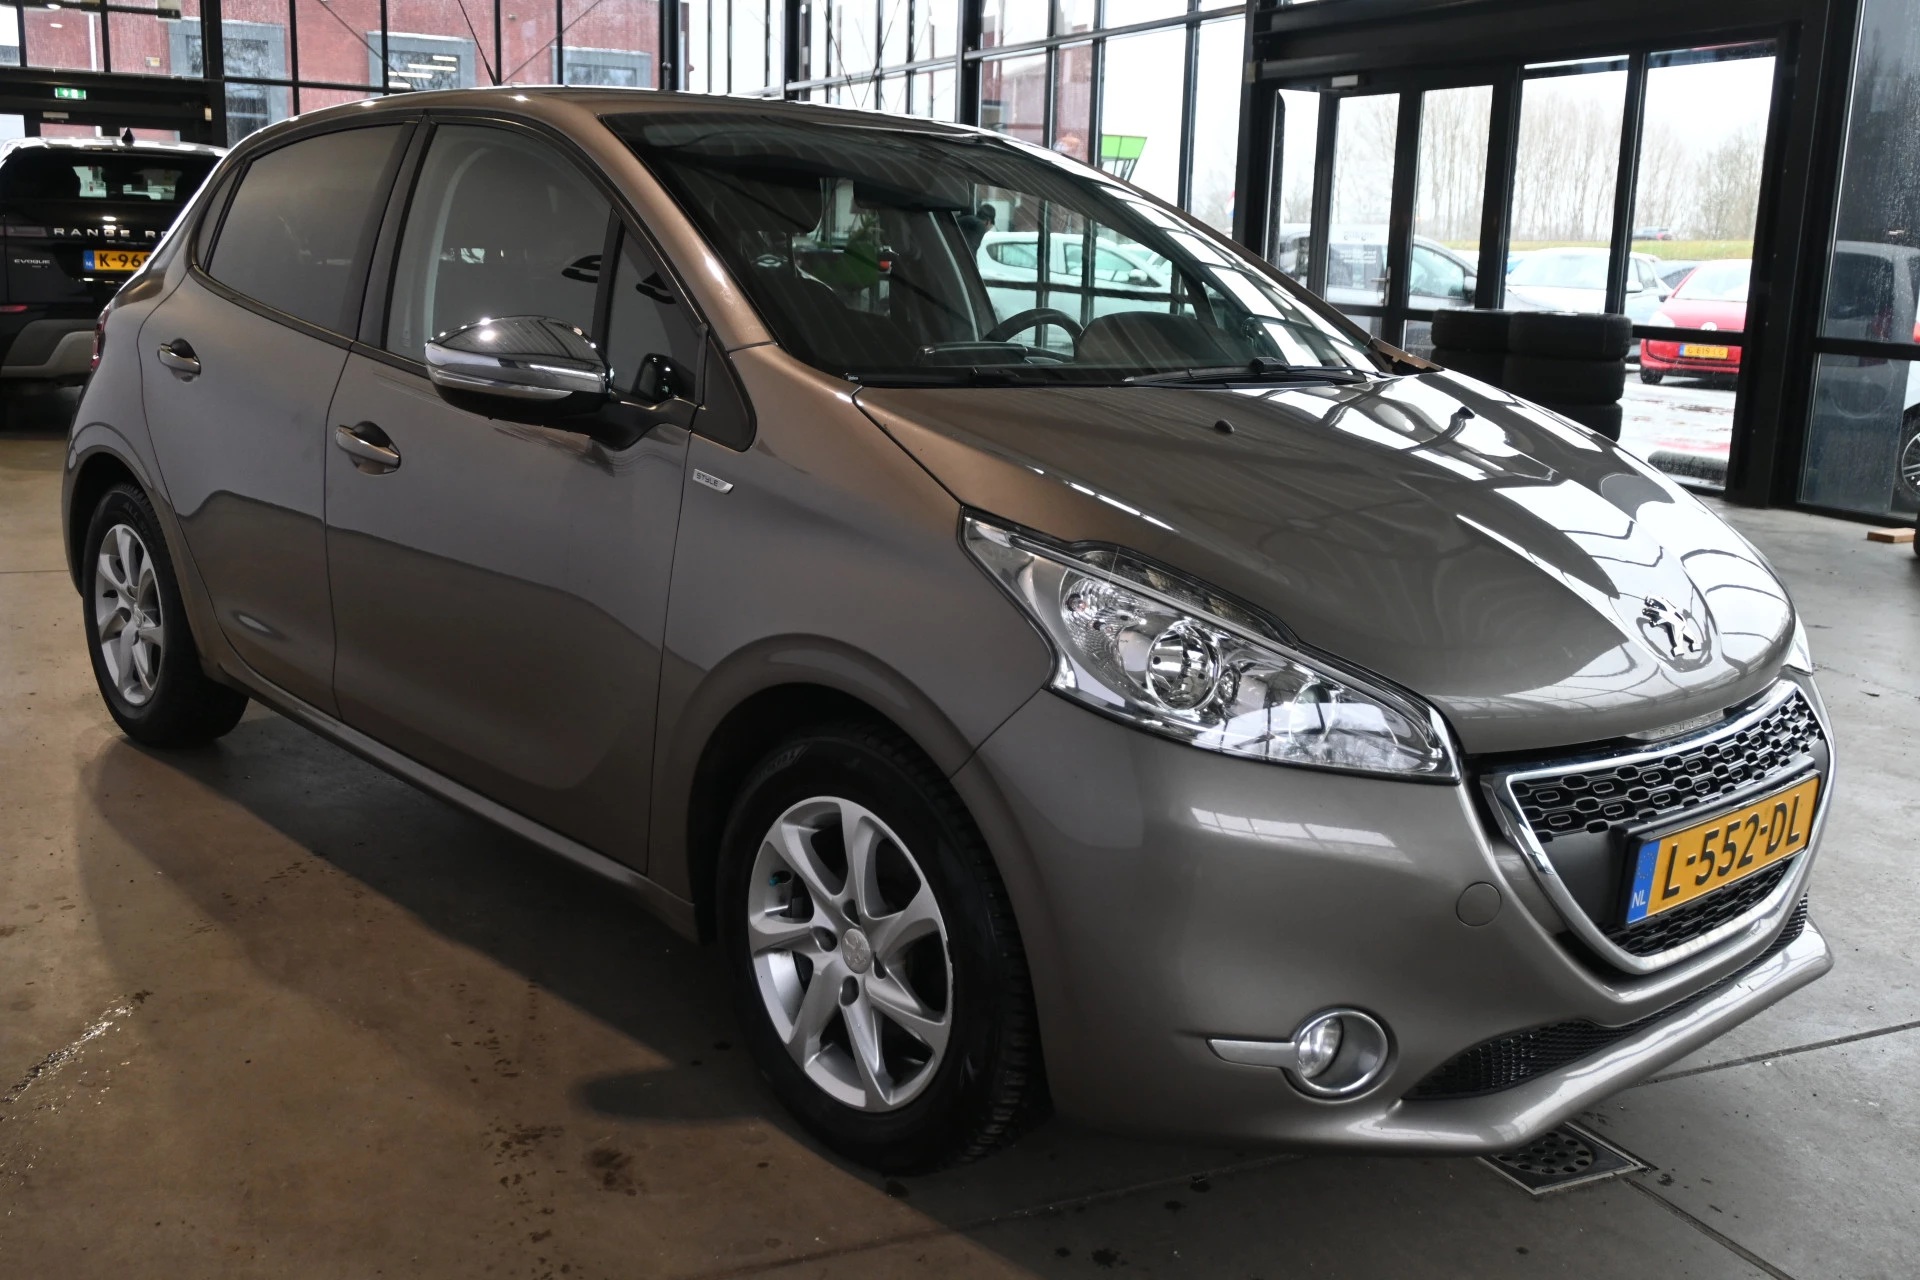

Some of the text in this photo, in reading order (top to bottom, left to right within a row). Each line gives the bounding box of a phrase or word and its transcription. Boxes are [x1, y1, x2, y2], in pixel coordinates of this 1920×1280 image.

[53, 228, 131, 238] RANGE
[696, 472, 719, 487] STYLE
[1631, 793, 1801, 909] NL L-552-DL
